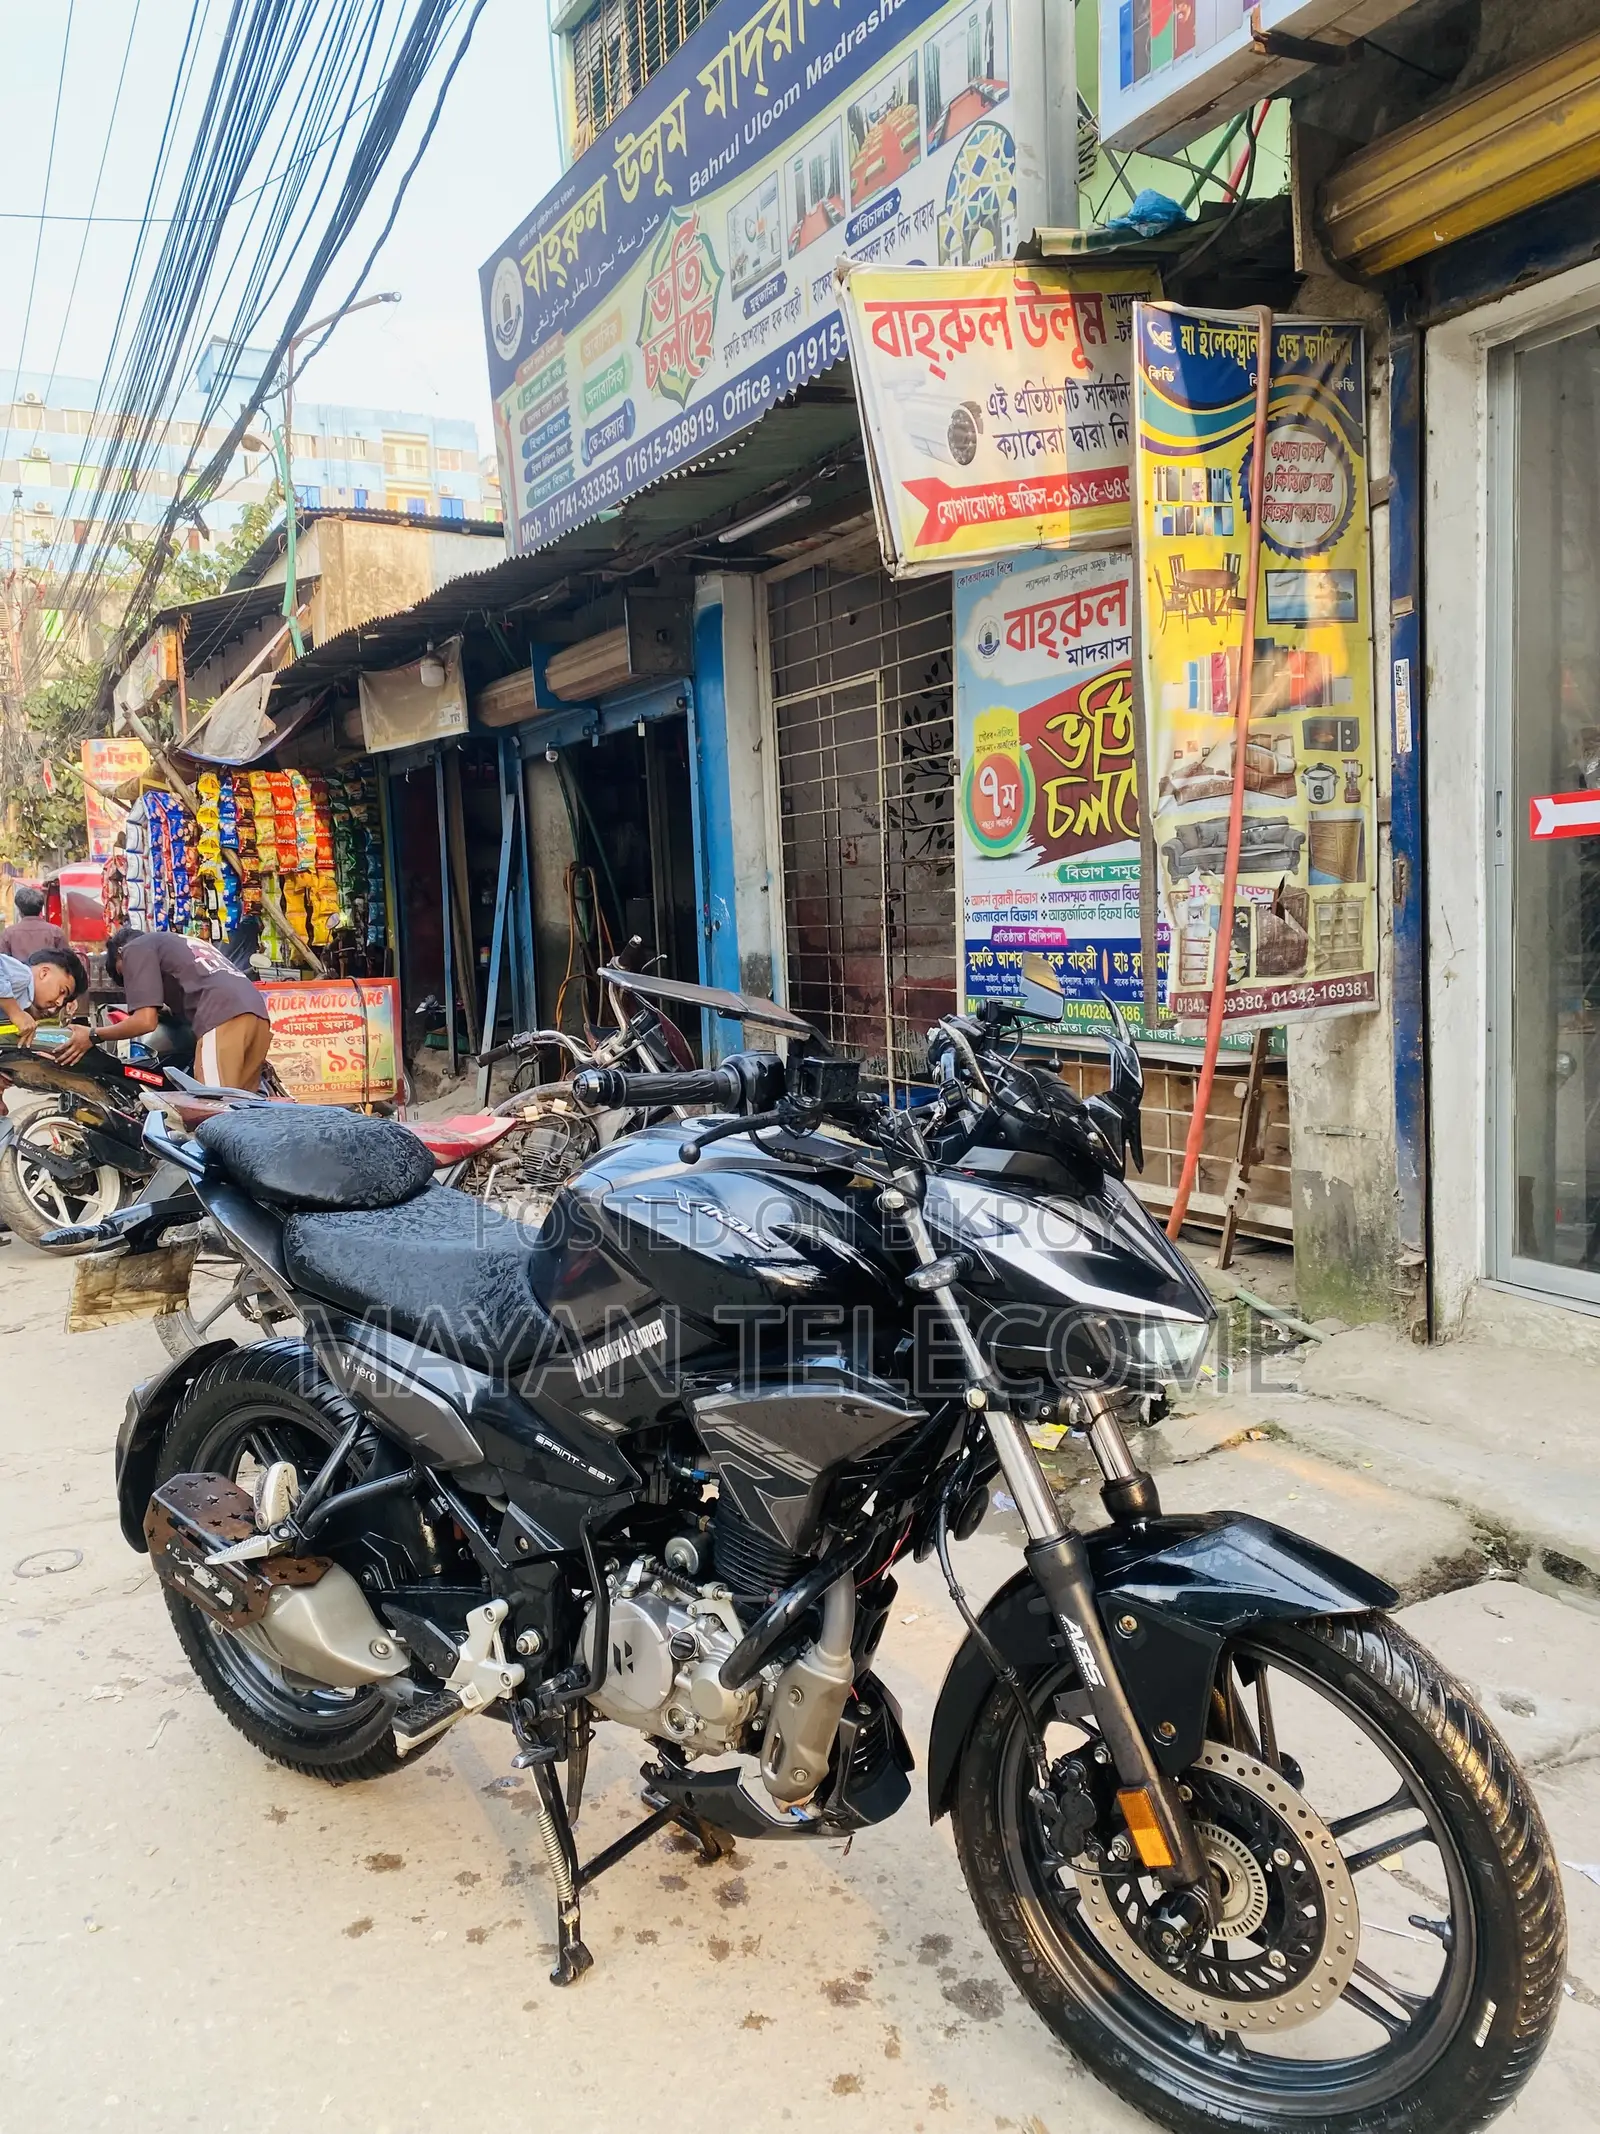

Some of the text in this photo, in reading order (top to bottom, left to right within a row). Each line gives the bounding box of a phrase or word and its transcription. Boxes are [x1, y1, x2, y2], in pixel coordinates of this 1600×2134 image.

[613, 88, 691, 203] উলূম
[689, 133, 740, 197] Bahrul
[743, 82, 800, 145] Uloom
[617, 213, 660, 255] مدرسة
[646, 204, 702, 324] ভর্তি
[583, 319, 618, 356] আবাসিক
[642, 293, 714, 391] চলছে
[1014, 278, 1106, 371] উলূম
[586, 365, 625, 406] অনাবাসিক
[987, 384, 1012, 420] এই
[1014, 376, 1079, 415] প্রতিষ্ঠানটি
[993, 426, 1065, 461] ক্যামেরা
[1069, 420, 1107, 451] দ্বারা
[522, 519, 541, 547] Mob
[548, 465, 624, 530] 01741-333353,
[626, 411, 719, 482] 01615-298919,
[722, 374, 770, 421] Office
[1065, 636, 1132, 666] মাদরাস
[1065, 865, 1105, 881] বিভাগ
[1010, 906, 1038, 923] বিভাগ
[1016, 888, 1038, 905] বিভাগ
[967, 945, 994, 972] মুফতি
[267, 996, 307, 1012] RIDER
[309, 993, 347, 1009] MOTO
[1271, 981, 1369, 1007] 01342-169381
[303, 1036, 339, 1048] ফোম
[352, 1363, 378, 1384] Hero
[535, 1433, 579, 1464] SPRINT
[1062, 1613, 1106, 1689] ABS
